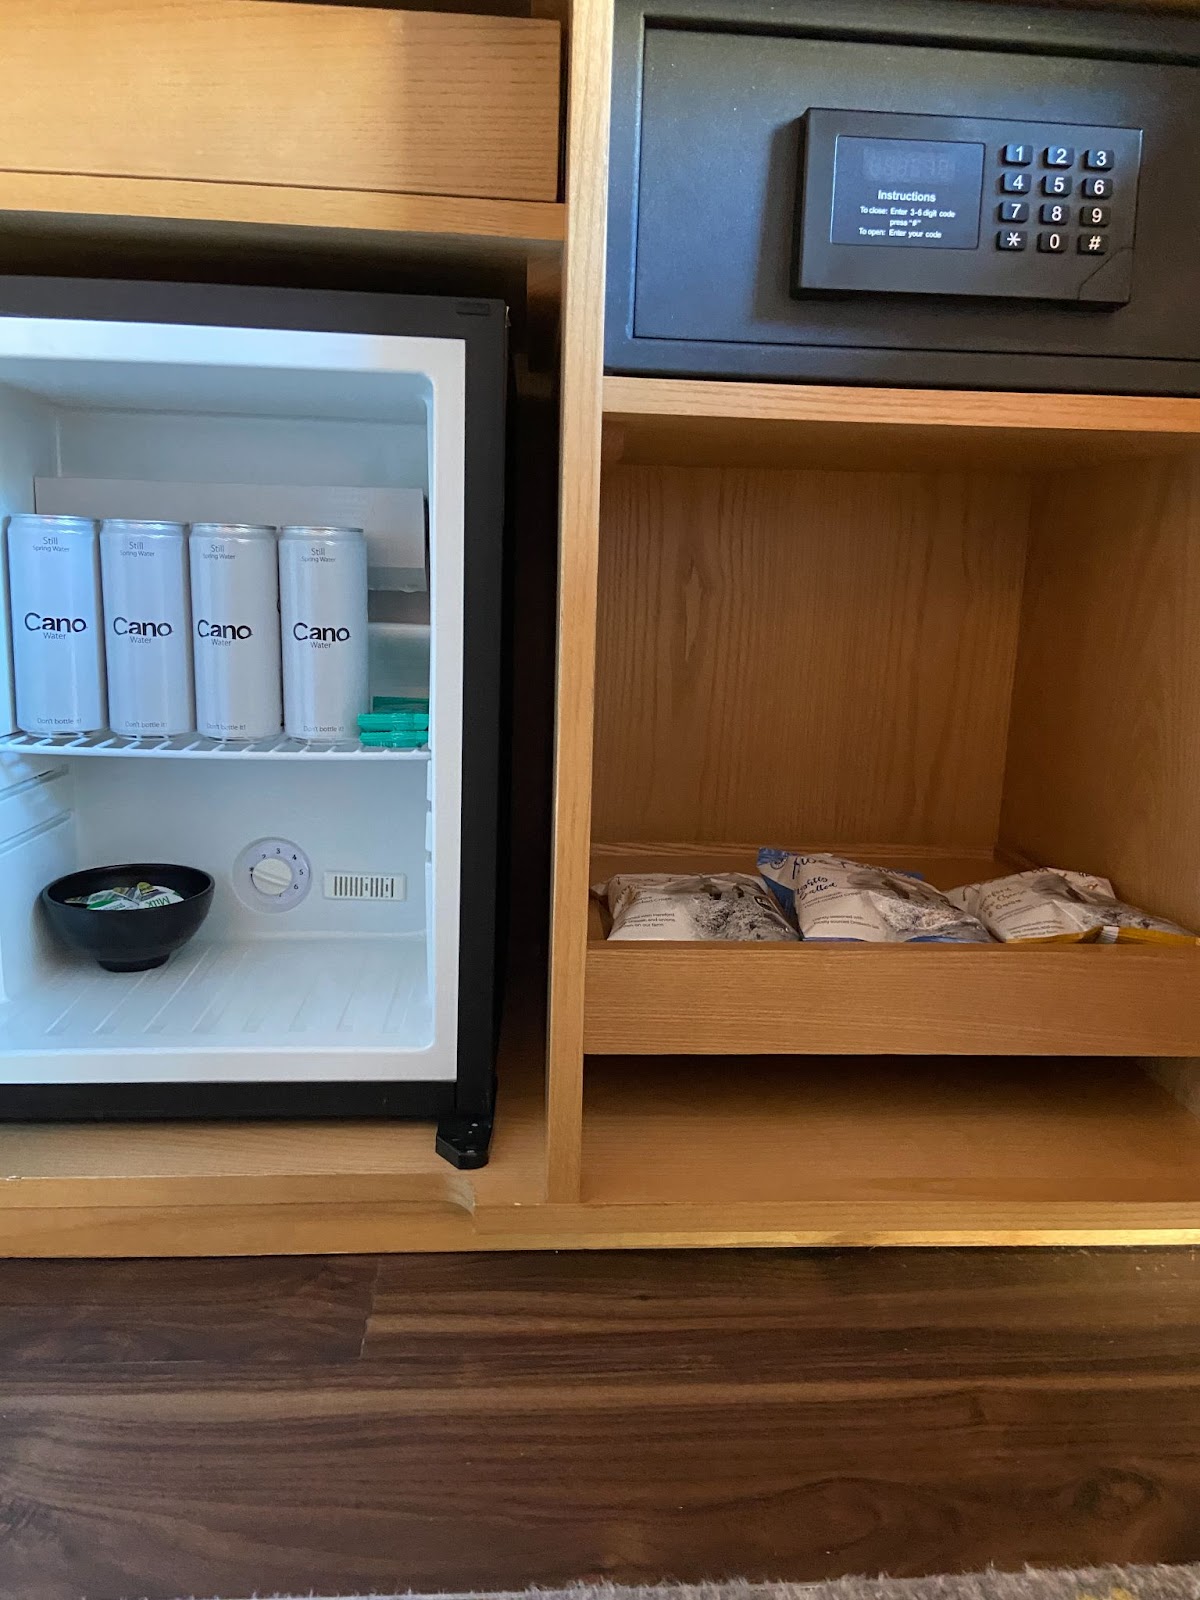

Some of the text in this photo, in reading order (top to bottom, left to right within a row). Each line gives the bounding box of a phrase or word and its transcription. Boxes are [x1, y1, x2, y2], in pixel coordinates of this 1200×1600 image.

[1015, 146, 1023, 161] 1
[1056, 149, 1067, 164] 2
[1096, 151, 1107, 166] 3
[1013, 175, 1023, 190] 4
[1054, 177, 1064, 192] 5
[1094, 180, 1104, 195] 6
[877, 189, 937, 202] Instructions
[860, 205, 868, 214] To
[869, 206, 888, 215] close:
[890, 207, 908, 216] Enter
[923, 209, 937, 218] digit
[939, 210, 956, 218] code
[1011, 203, 1021, 218] 7
[1051, 206, 1062, 221] 8
[1091, 209, 1102, 223] 9
[889, 219, 908, 227] press
[859, 227, 942, 239] To open: Enter your code
[1049, 234, 1060, 249] 0
[43, 536, 58, 545] Still
[129, 541, 144, 550] Still
[32, 544, 51, 553] Spring
[120, 549, 137, 558] Spring
[211, 544, 224, 553] Still
[311, 547, 326, 556] Still
[203, 553, 218, 561] Spring
[24, 612, 87, 633] Cano
[113, 616, 173, 637] Cano
[197, 619, 252, 640] Cano
[293, 622, 350, 642] Cano
[43, 632, 67, 640] Water
[129, 635, 152, 644] Water
[211, 638, 232, 647] Water
[310, 641, 332, 649] Water
[37, 717, 53, 725] Don't
[125, 720, 140, 728] Don't
[221, 723, 238, 731] bottle
